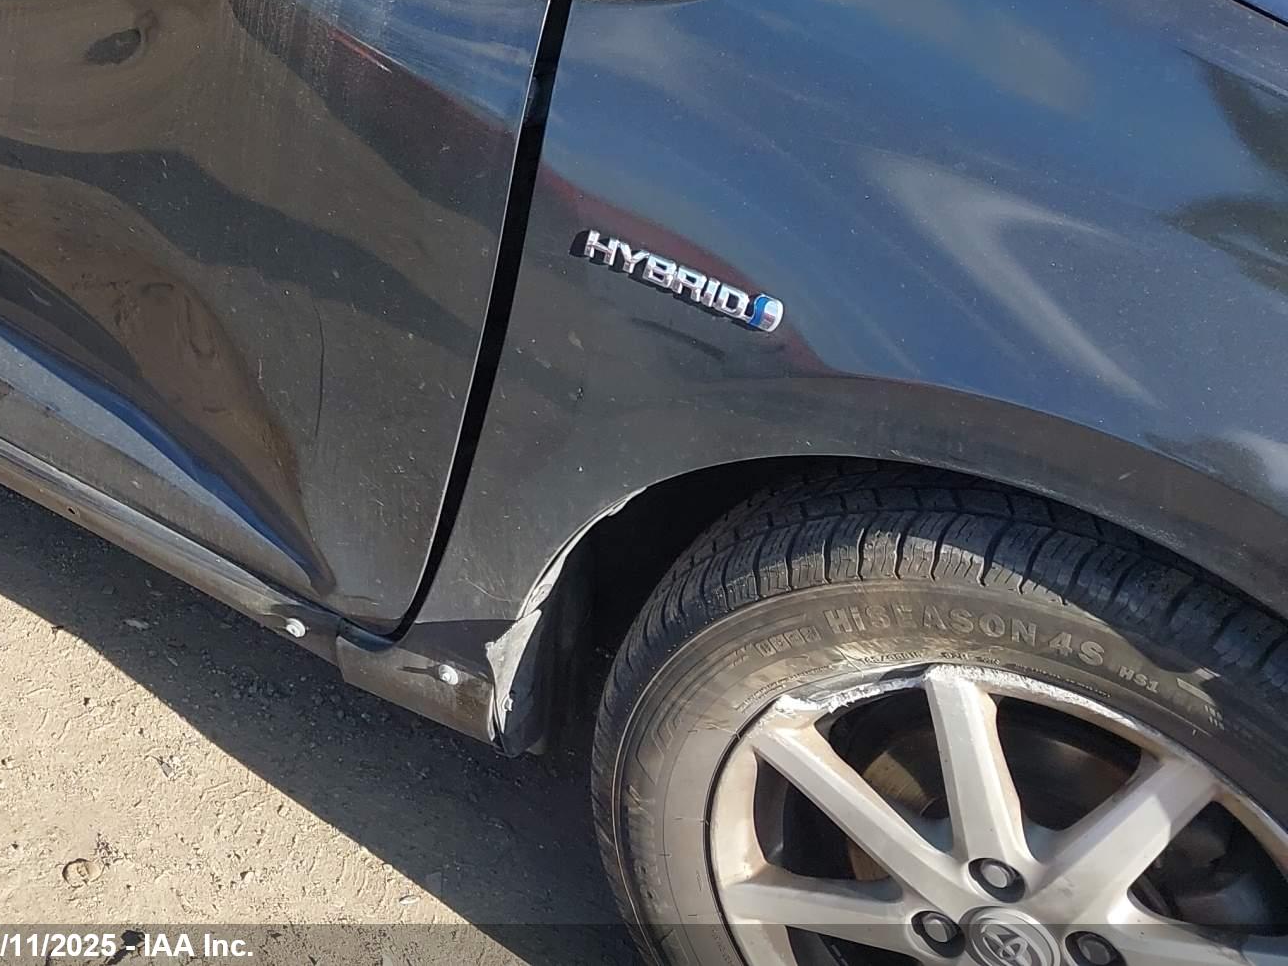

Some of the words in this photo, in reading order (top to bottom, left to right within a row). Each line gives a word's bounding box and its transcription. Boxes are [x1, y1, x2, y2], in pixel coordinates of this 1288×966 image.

[584, 229, 751, 321] HYBRID
[1048, 631, 1105, 666] 4S
[1118, 666, 1160, 694] HS1
